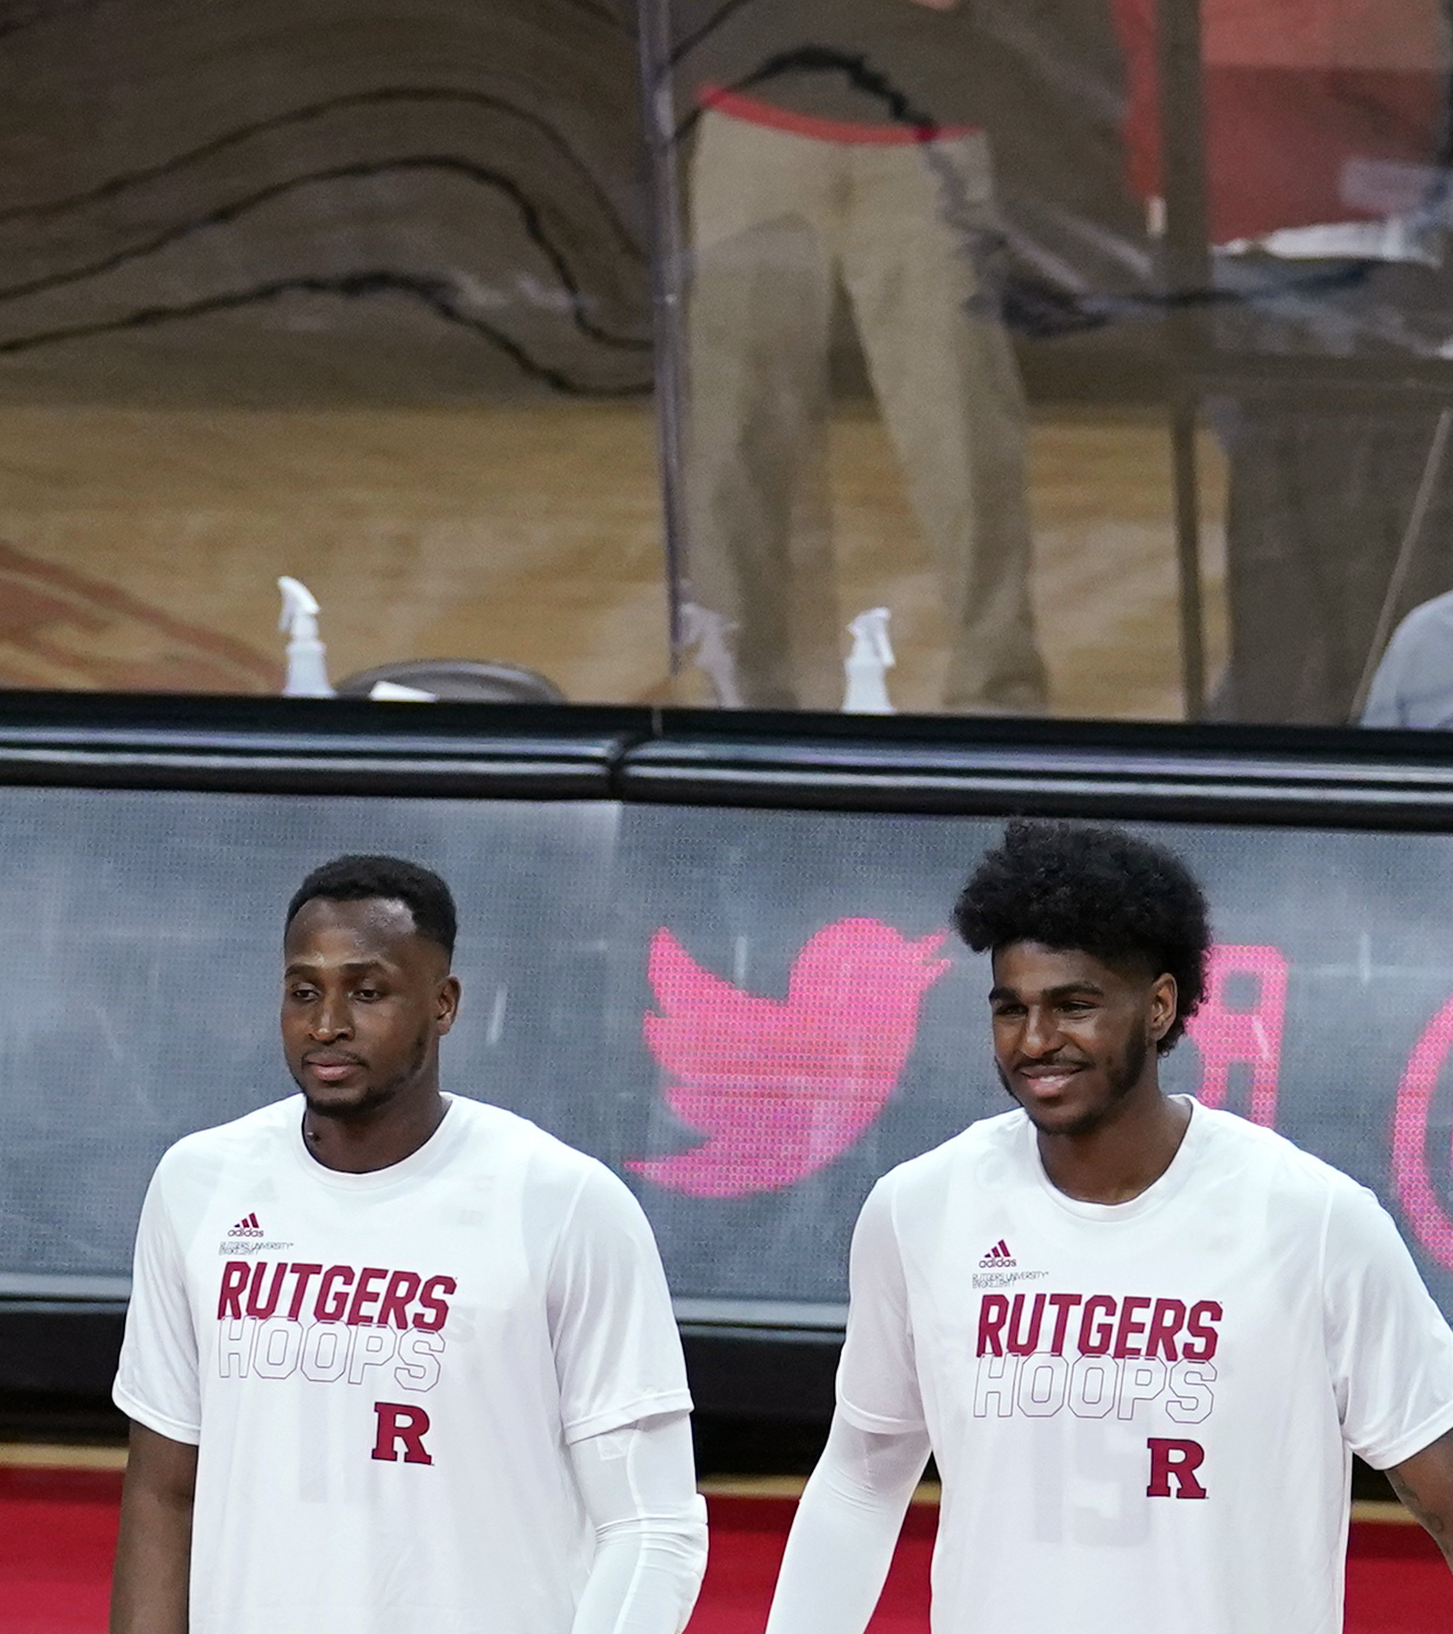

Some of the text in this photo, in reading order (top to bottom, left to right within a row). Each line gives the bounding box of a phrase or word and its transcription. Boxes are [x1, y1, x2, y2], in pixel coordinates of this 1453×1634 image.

[217, 1261, 457, 1333] RUTGERS
[978, 1257, 1017, 1268] adidas
[219, 1315, 445, 1392] HOOPS
[977, 1293, 1223, 1364] RUTGERS
[974, 1352, 1217, 1424] HOOPS
[371, 1401, 432, 1465] R
[1147, 1438, 1207, 1499] R
